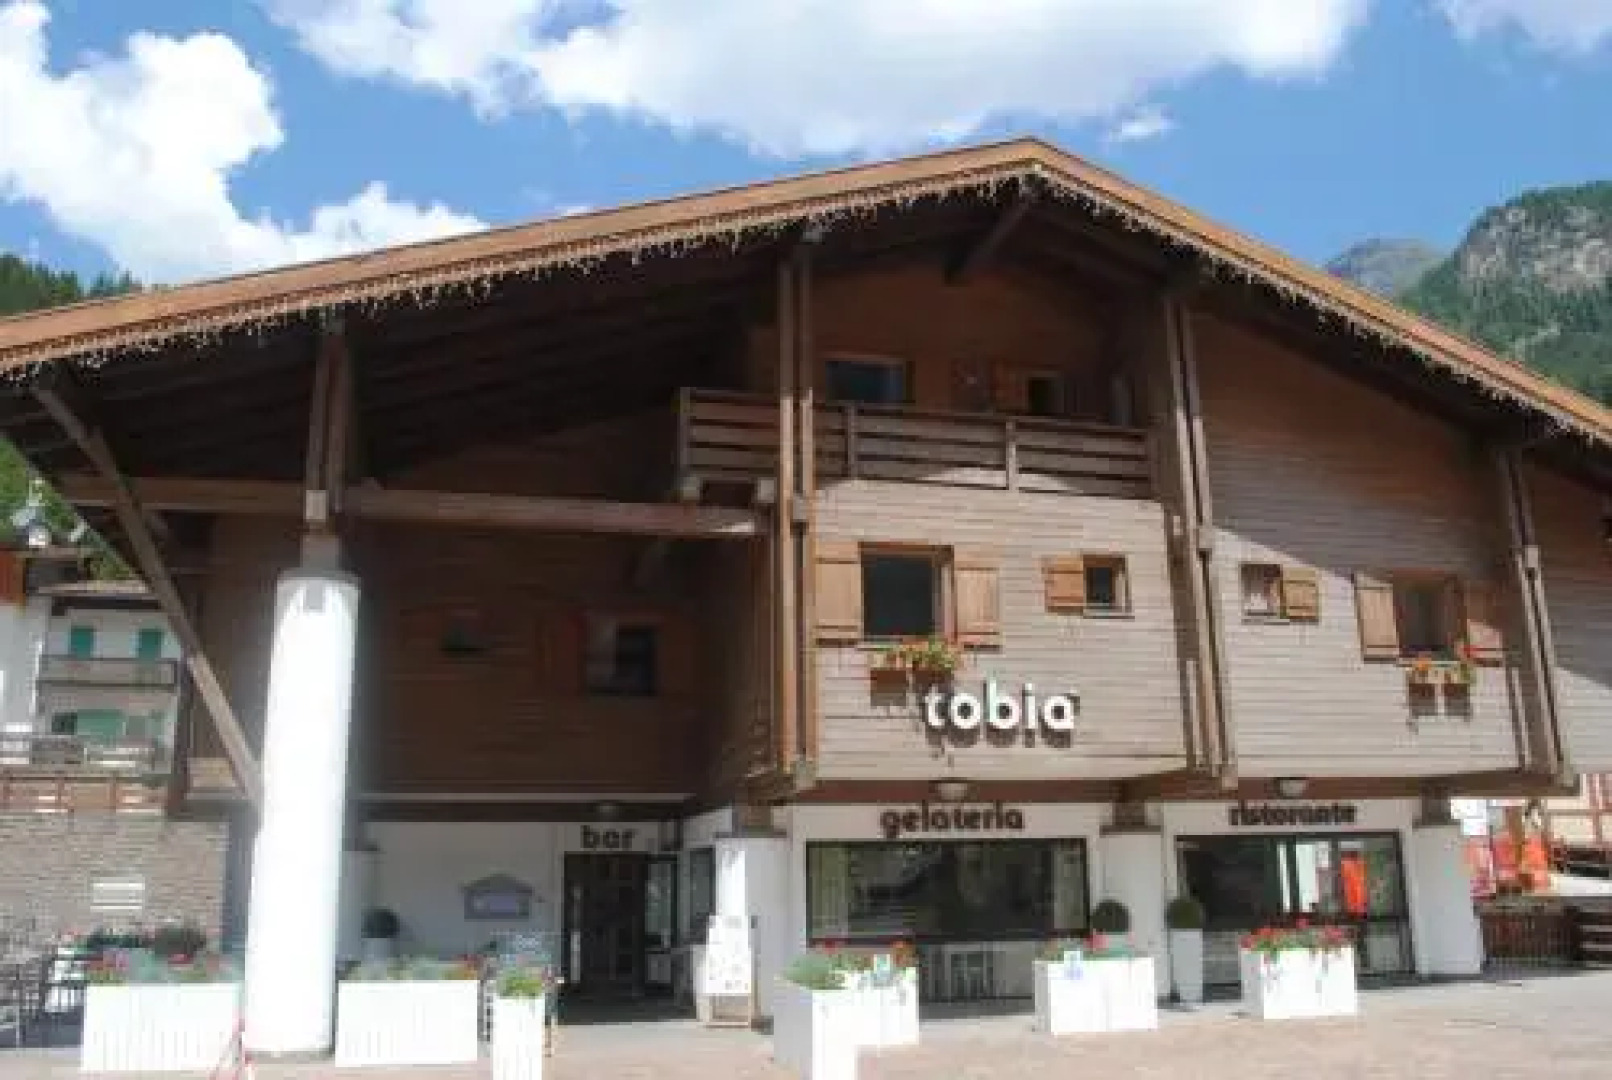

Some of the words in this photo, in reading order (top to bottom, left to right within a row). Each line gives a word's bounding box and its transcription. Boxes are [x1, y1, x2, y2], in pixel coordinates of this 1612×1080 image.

[924, 679, 1076, 731] tobia
[879, 799, 1024, 839] gelateria
[1230, 801, 1357, 825] ristorante
[581, 824, 638, 850] bar
